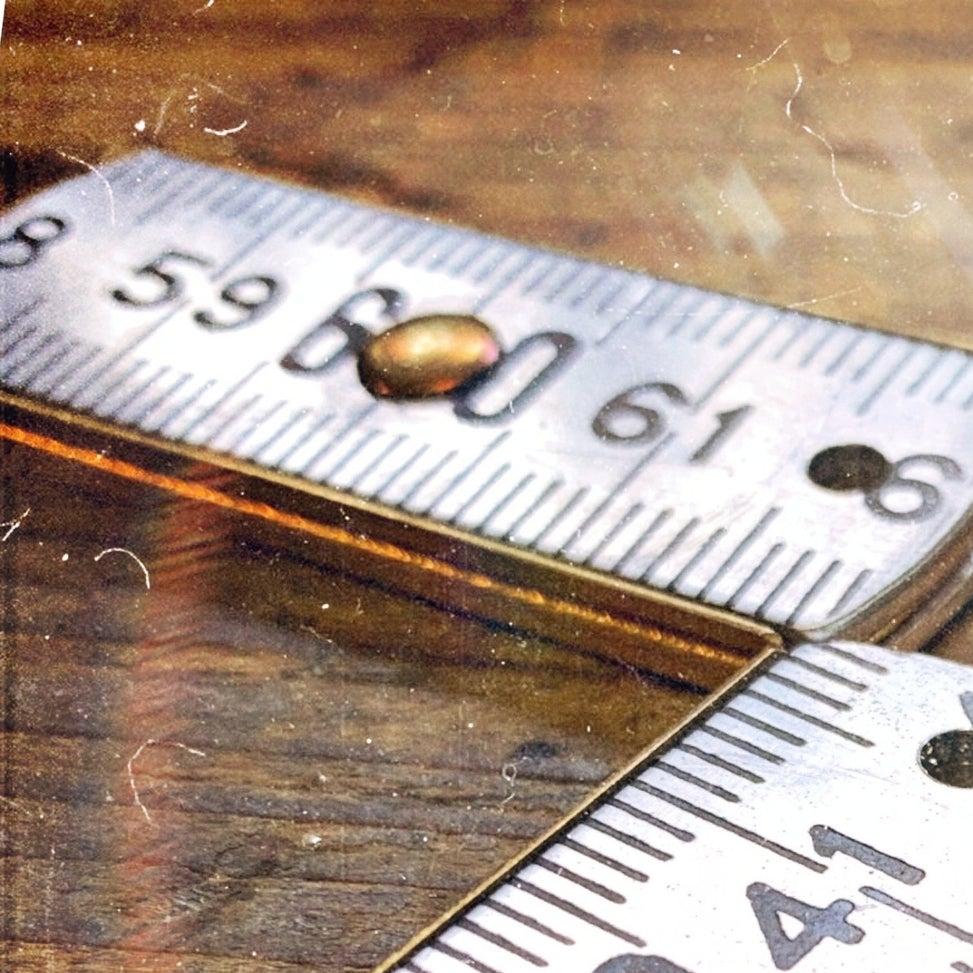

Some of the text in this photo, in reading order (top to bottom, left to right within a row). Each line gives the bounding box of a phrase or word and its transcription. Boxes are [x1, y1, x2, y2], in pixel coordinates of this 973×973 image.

[109, 250, 282, 333] 59
[280, 287, 579, 428] 60
[592, 380, 757, 465] 61
[862, 453, 968, 524] 6
[746, 823, 927, 971] 41
